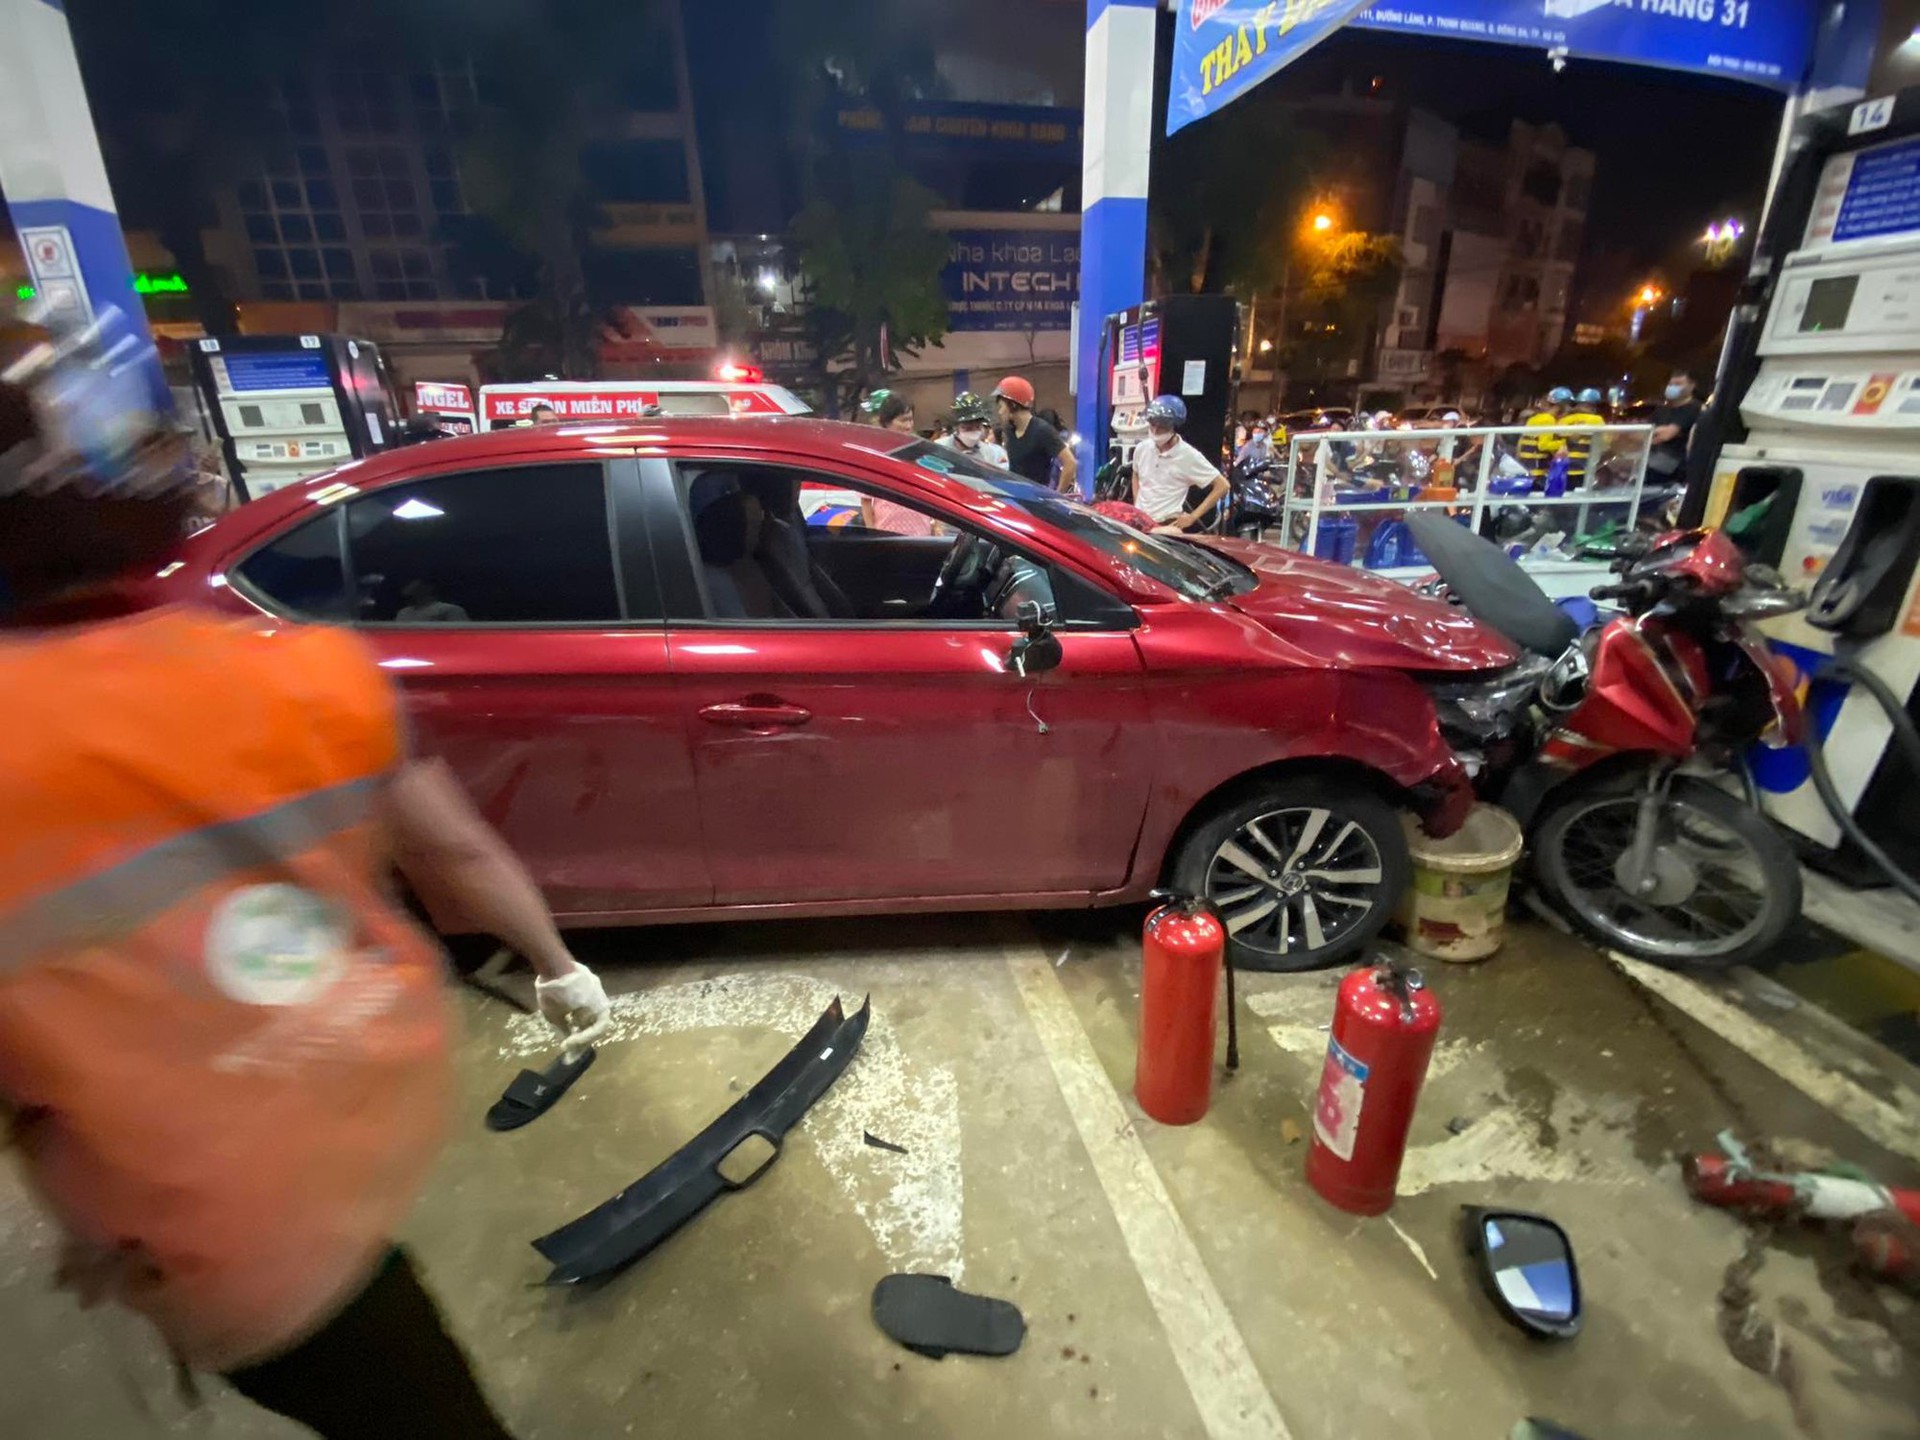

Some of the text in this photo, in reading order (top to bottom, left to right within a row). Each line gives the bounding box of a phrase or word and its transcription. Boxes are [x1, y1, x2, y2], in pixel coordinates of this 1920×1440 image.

[1720, 0, 1748, 29] 31
[1200, 2, 1277, 96] THAY
[962, 271, 1072, 292] INTECH
[495, 400, 515, 415] XE
[616, 397, 644, 414] PHÍ
